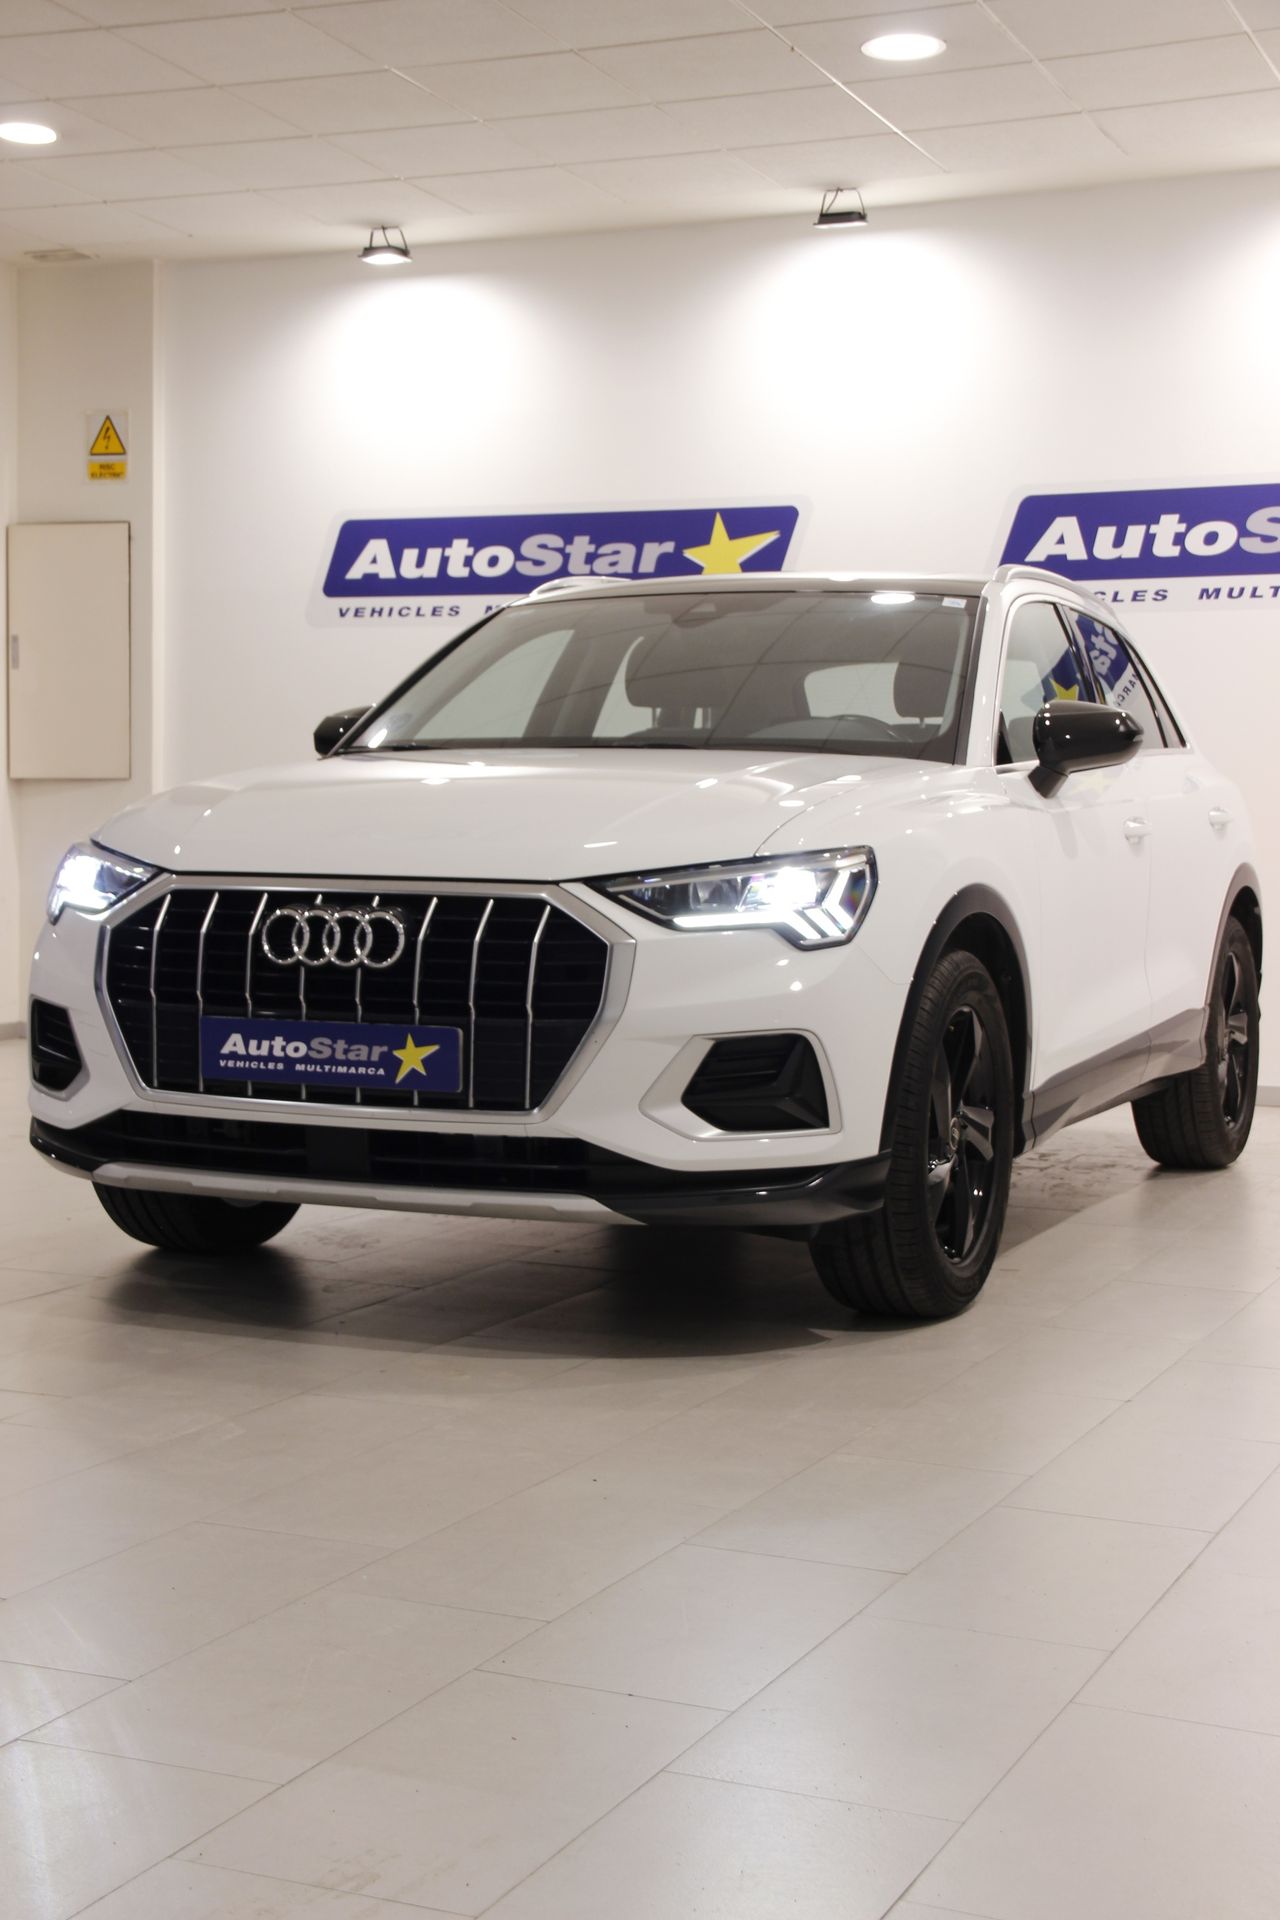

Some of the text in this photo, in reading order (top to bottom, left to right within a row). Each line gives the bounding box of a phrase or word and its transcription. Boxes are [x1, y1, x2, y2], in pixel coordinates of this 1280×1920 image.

[1024, 506, 1280, 562] AutoS
[345, 534, 675, 580] AutoStar
[338, 605, 461, 619] VEHICLES
[220, 1033, 388, 1062] AutoStar
[219, 1060, 385, 1076] VEHICLES MULTIMARCA
